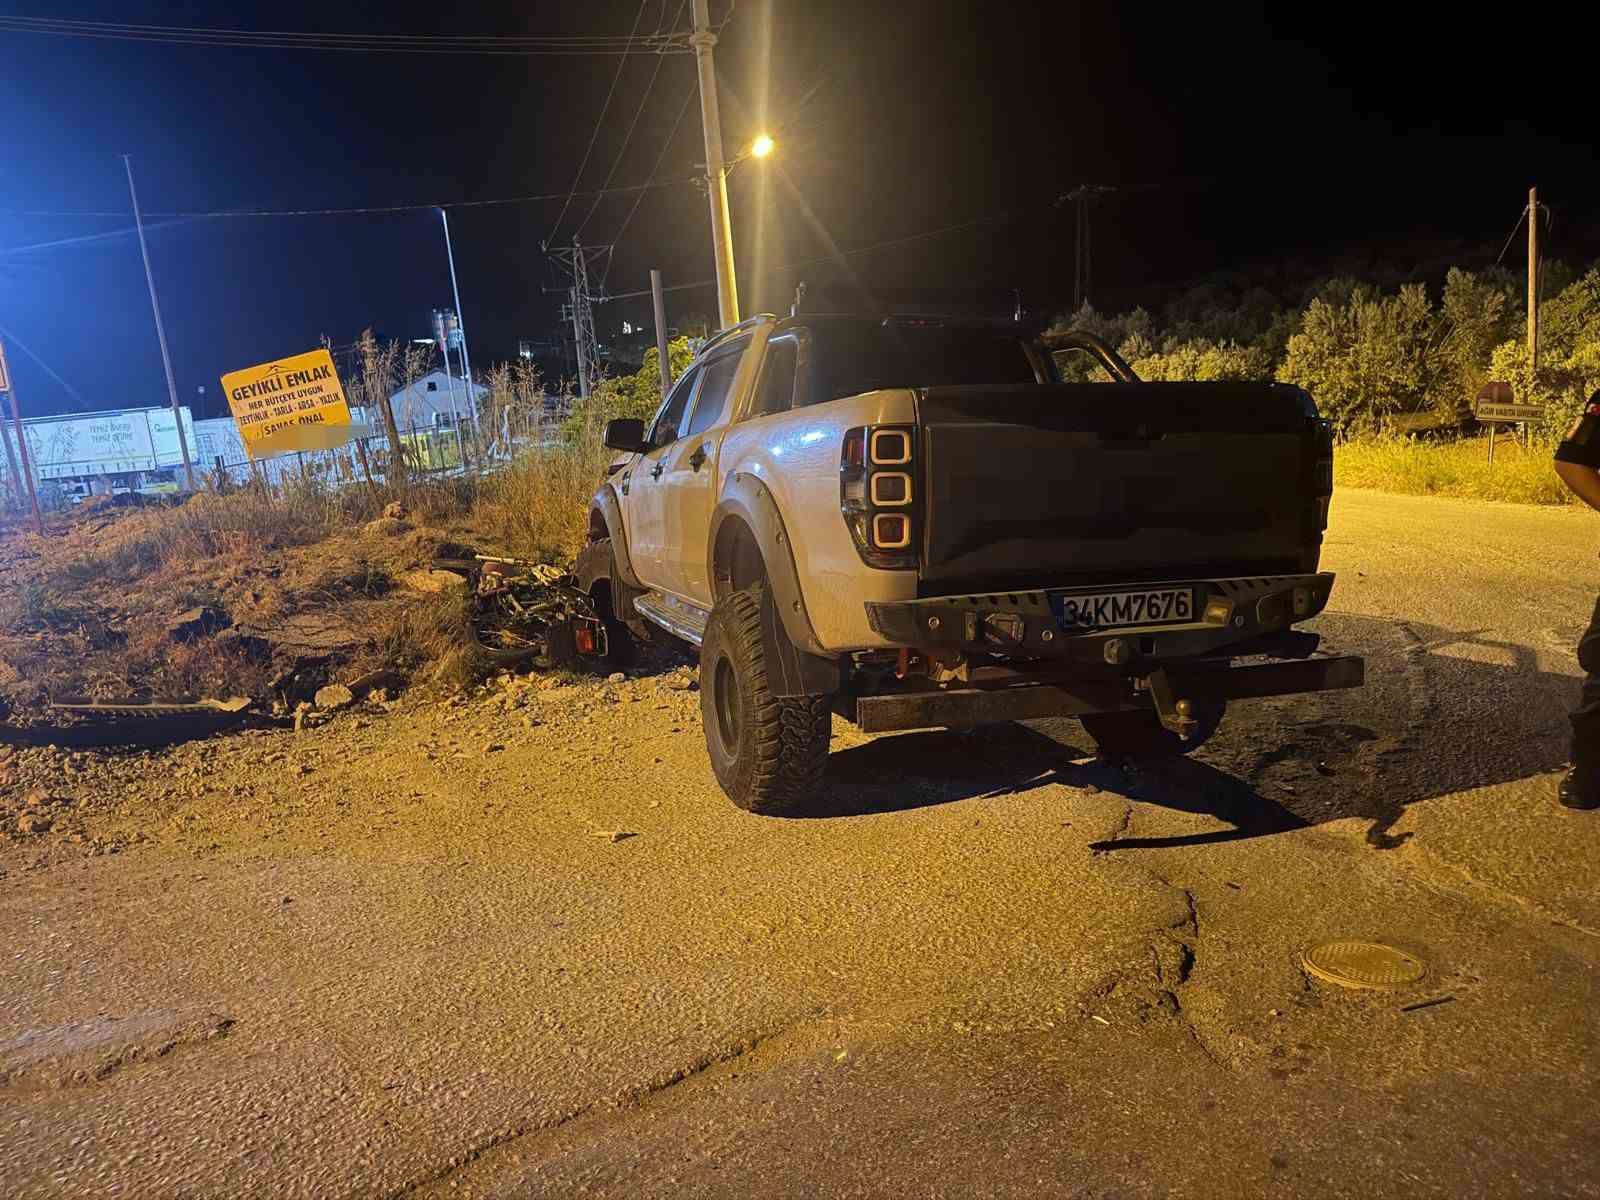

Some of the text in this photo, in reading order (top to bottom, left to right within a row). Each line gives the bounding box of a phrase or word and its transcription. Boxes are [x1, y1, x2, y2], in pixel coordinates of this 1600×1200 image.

[232, 365, 331, 401] GEYİKLİ EMLAK
[248, 400, 264, 411] HER
[297, 385, 324, 399] UYGUN
[273, 405, 293, 417] TARLA
[319, 392, 341, 406] YAZLIK
[1064, 592, 1188, 625] 34KM7676
